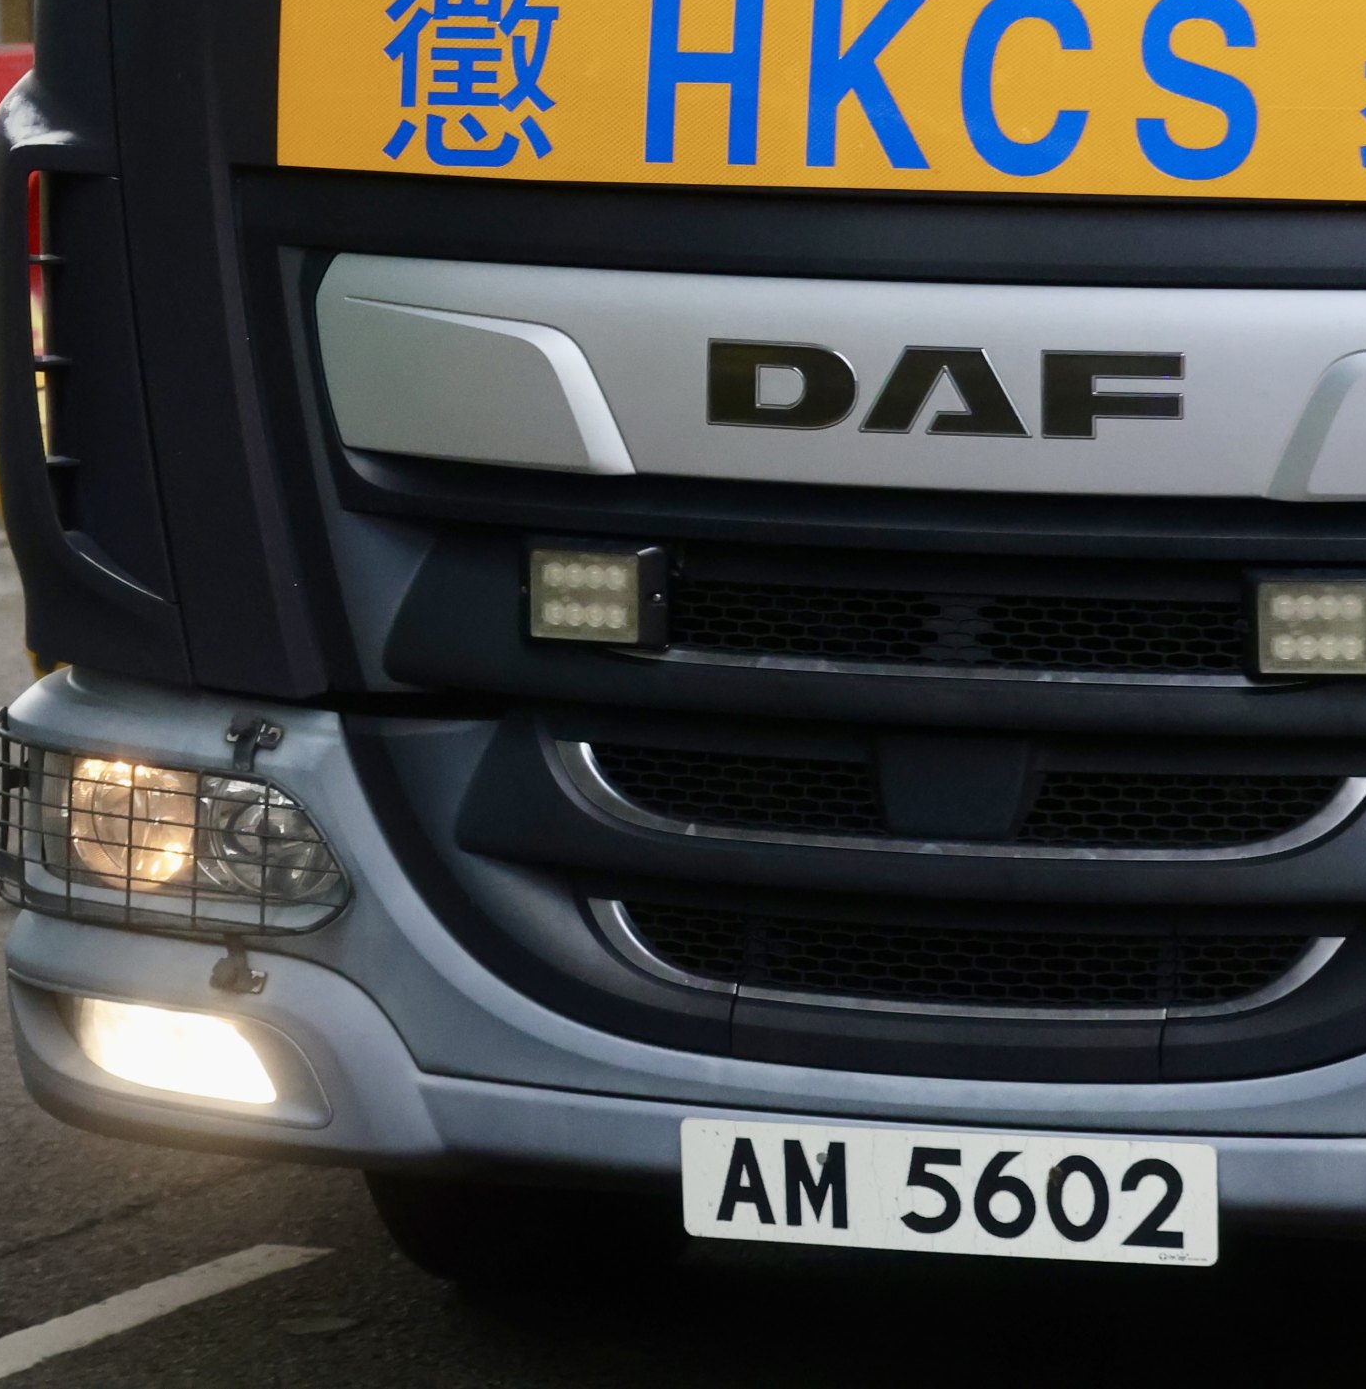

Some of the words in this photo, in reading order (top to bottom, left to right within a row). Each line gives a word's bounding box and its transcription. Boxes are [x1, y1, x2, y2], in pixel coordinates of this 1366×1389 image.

[706, 337, 1186, 440] DAF
[716, 1137, 849, 1229] AM
[899, 1146, 1184, 1250] 5602
